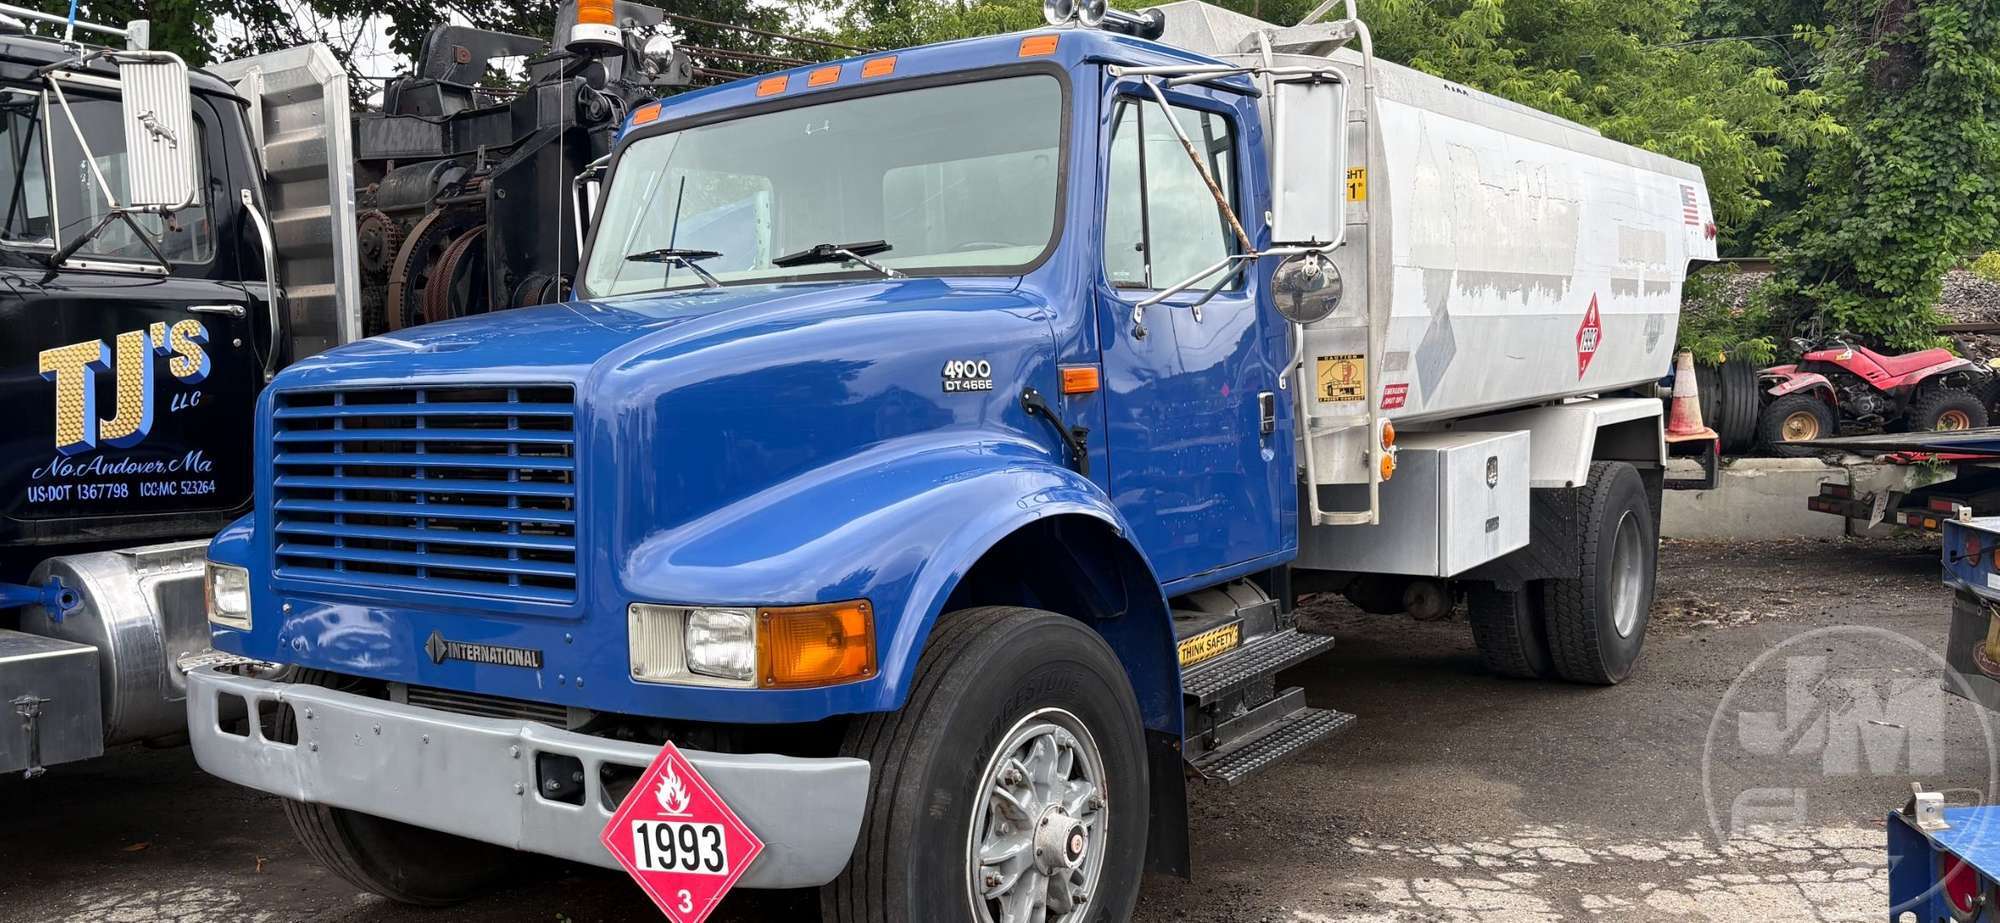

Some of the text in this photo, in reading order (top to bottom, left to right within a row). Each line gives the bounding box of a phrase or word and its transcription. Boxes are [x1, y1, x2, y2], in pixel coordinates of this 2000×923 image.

[1582, 328, 1597, 351] 1993
[944, 360, 991, 378] 4900
[945, 380, 993, 391] DT 466E
[170, 391, 202, 412] LLC
[32, 450, 213, 480] No. Andover, Ma
[77, 483, 129, 500] 1367798
[180, 480, 216, 495] 523264
[448, 643, 538, 667] INTERNATIONAL
[1182, 632, 1234, 660] THINK SAFETY
[636, 822, 726, 873] 1993
[677, 889, 694, 914] 3
